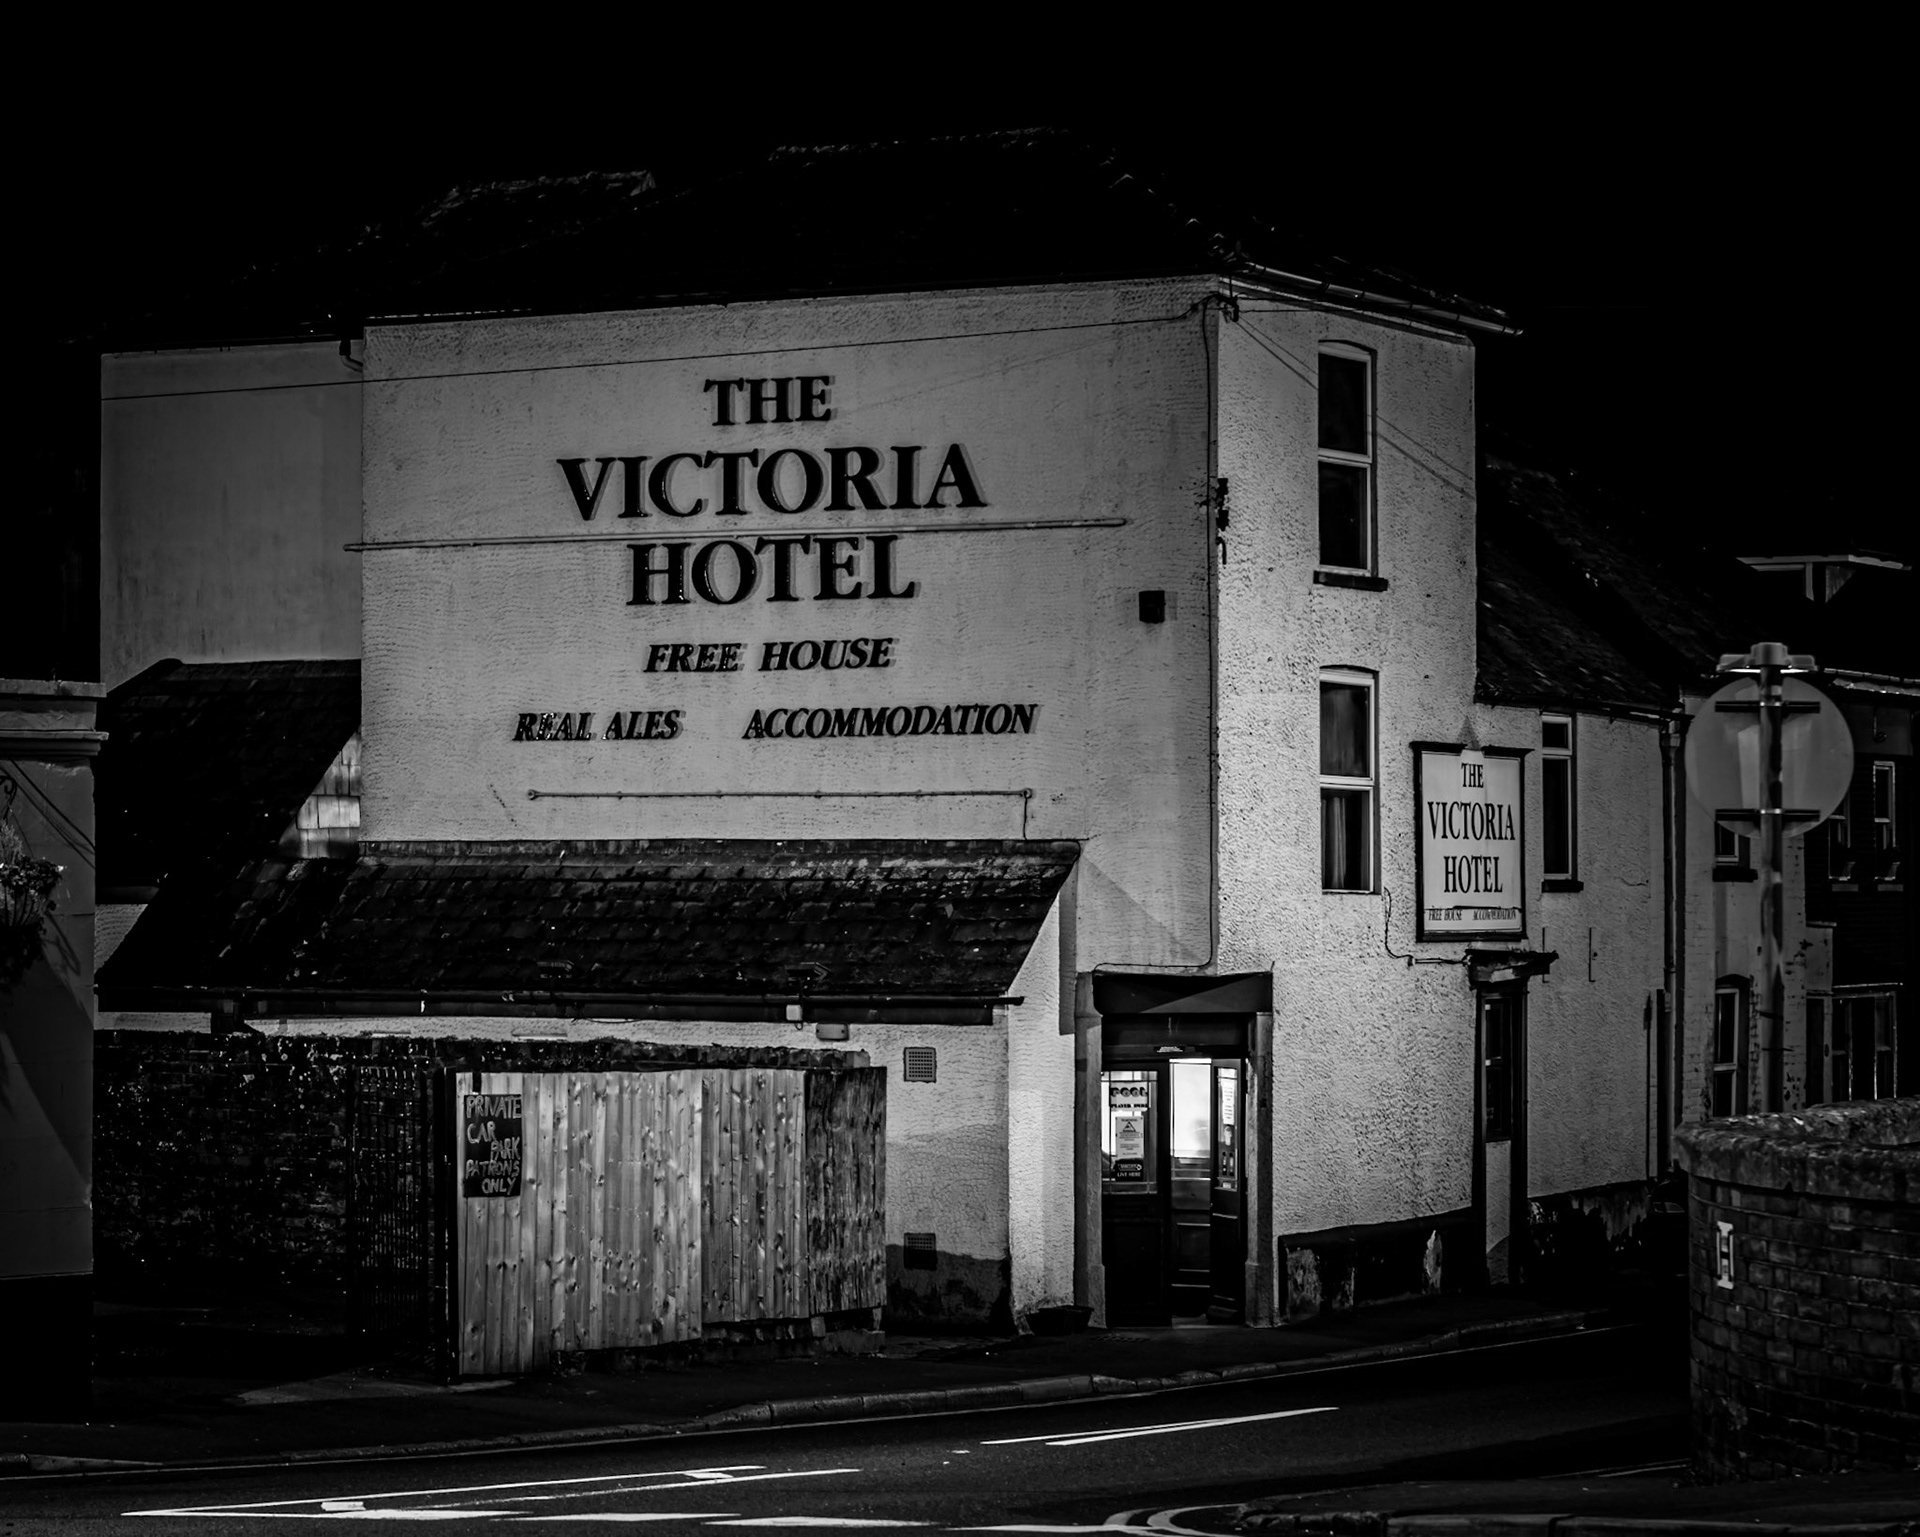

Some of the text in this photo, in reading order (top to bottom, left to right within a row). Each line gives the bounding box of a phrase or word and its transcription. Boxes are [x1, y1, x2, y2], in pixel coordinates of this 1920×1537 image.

[703, 375, 833, 426] THE
[556, 443, 989, 521] VICTORIA
[626, 534, 917, 606] HOTEL
[643, 637, 894, 673] FREE HOUSE
[513, 703, 1038, 742] REAL ALES ACCOMMODATION
[1461, 762, 1484, 788] THE
[1427, 801, 1516, 840] VICTORIA
[1443, 855, 1503, 893] HOTEL
[1428, 909, 1442, 921] FREE
[466, 1095, 521, 1119] PRIVATE
[467, 1121, 497, 1144] CAR
[491, 1137, 520, 1161] PARK
[466, 1159, 520, 1179] PATRONS
[482, 1177, 516, 1195] ONLY
